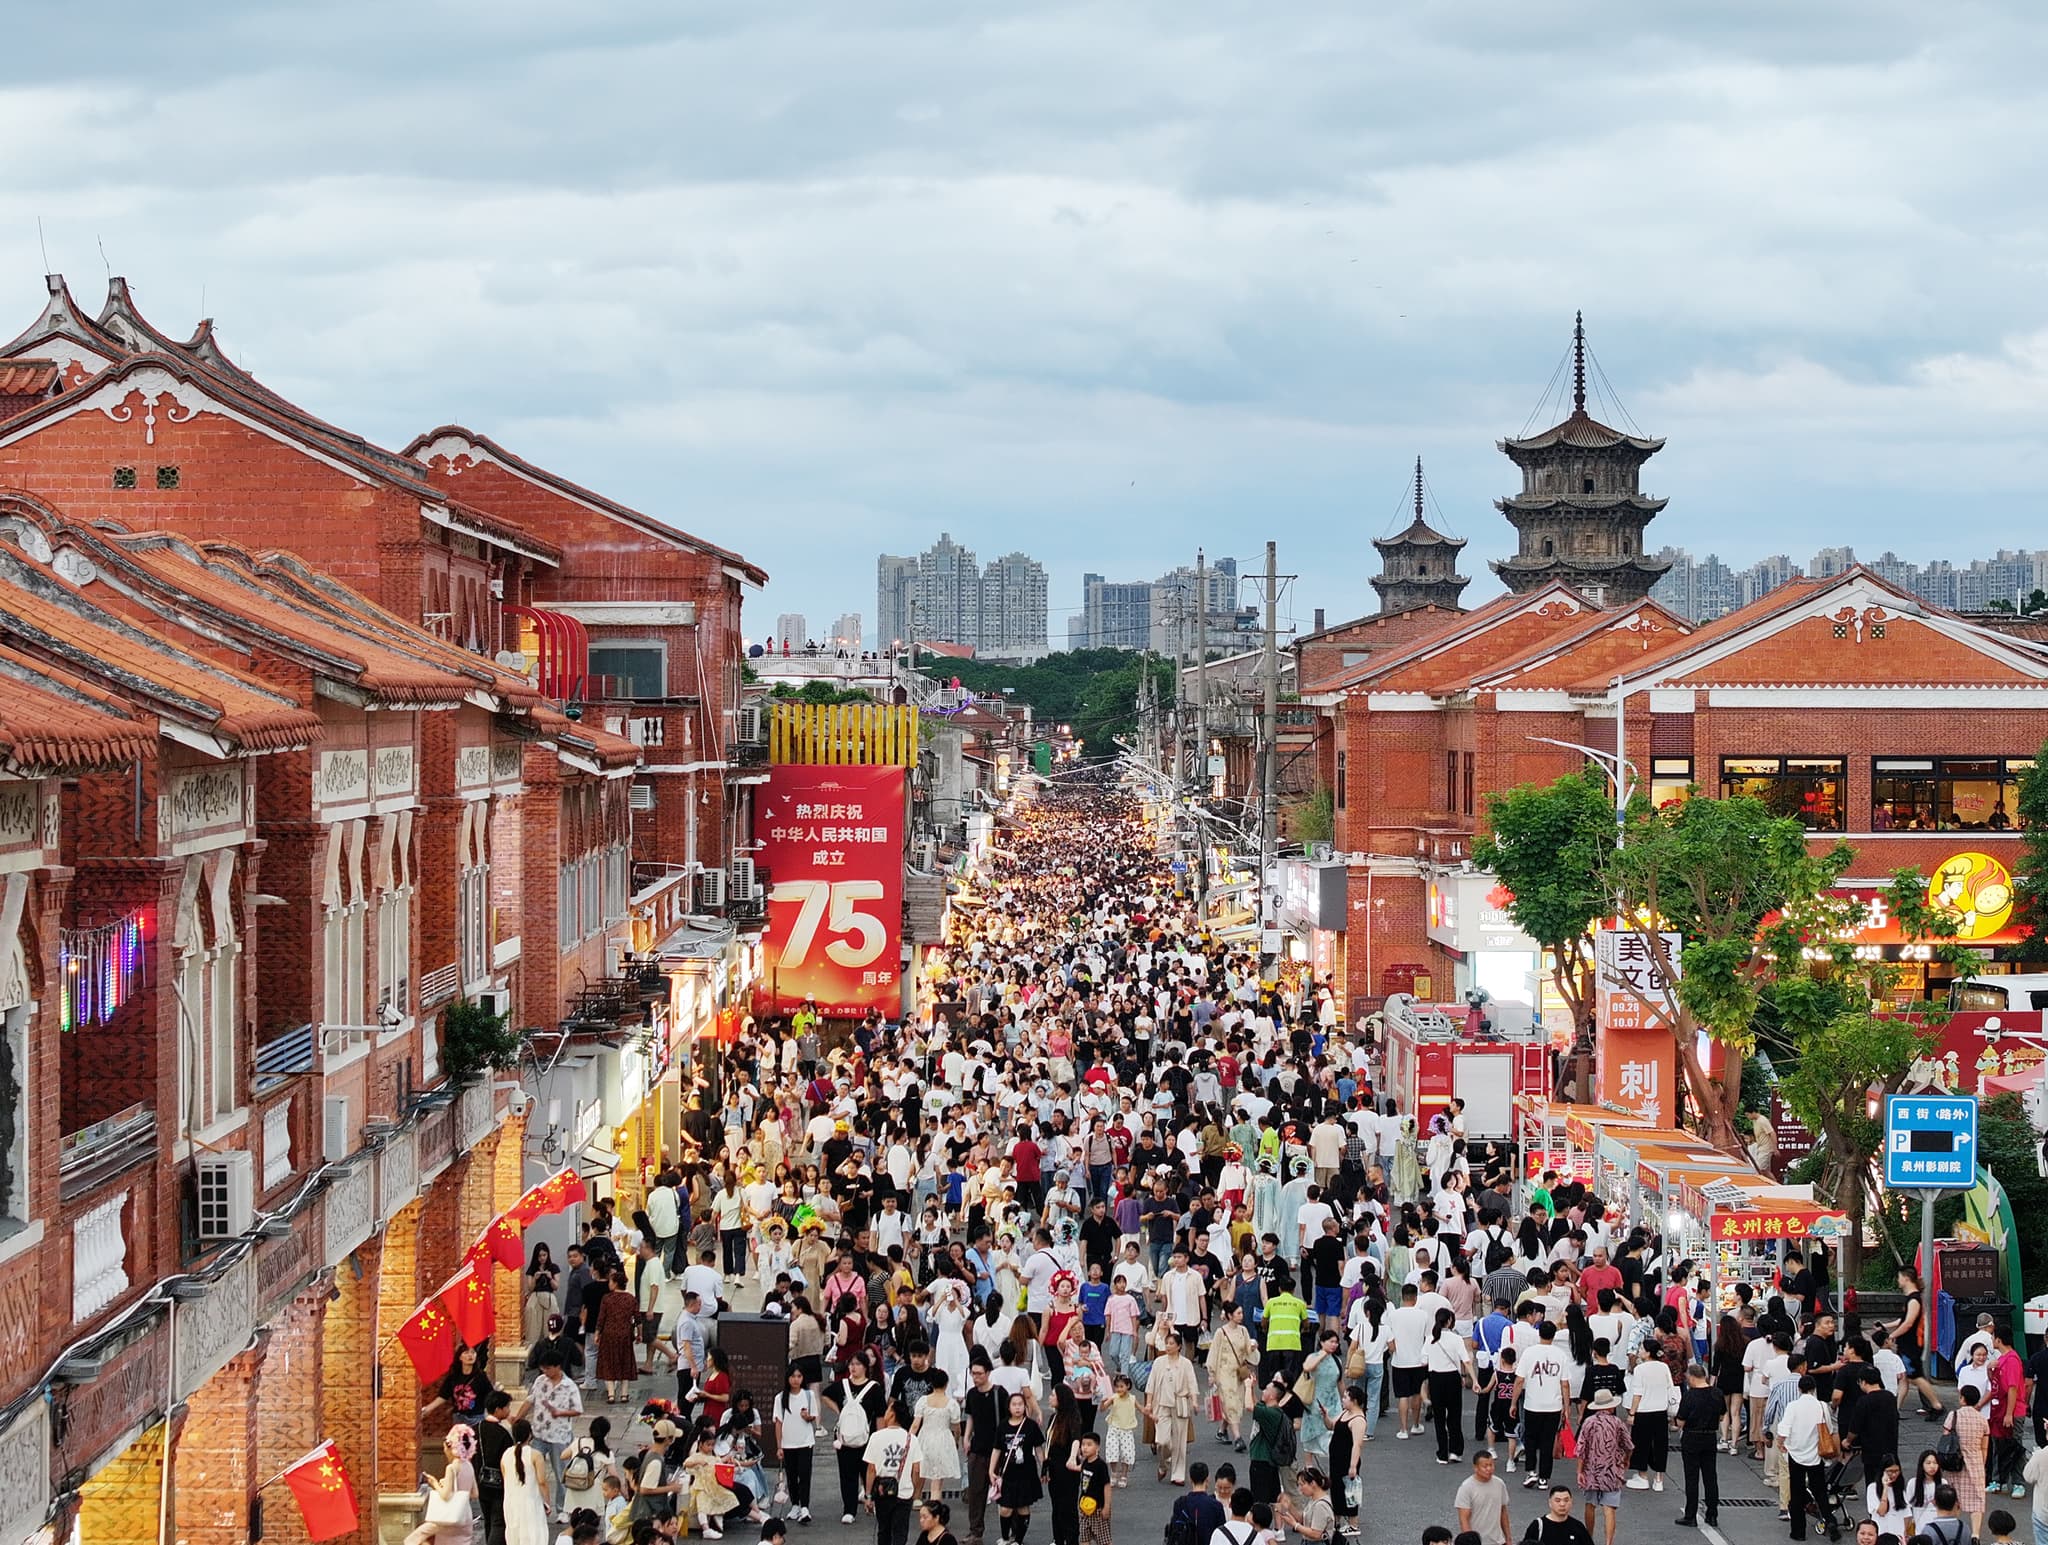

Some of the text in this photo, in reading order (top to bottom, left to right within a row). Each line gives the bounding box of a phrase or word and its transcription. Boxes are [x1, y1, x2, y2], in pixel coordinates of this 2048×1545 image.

[795, 803, 863, 820] 热烈庆祝
[771, 826, 888, 843] 中华人民共和国
[812, 850, 845, 866] 成立
[768, 880, 887, 968] 75
[862, 971, 892, 986] 周年
[1612, 1002, 1640, 1012] 09.28
[1613, 1017, 1640, 1027] 10.07
[1895, 1133, 1907, 1150] P
[1901, 1160, 1962, 1173] 泉州影剧院
[1721, 1216, 1806, 1236] 泉州特色
